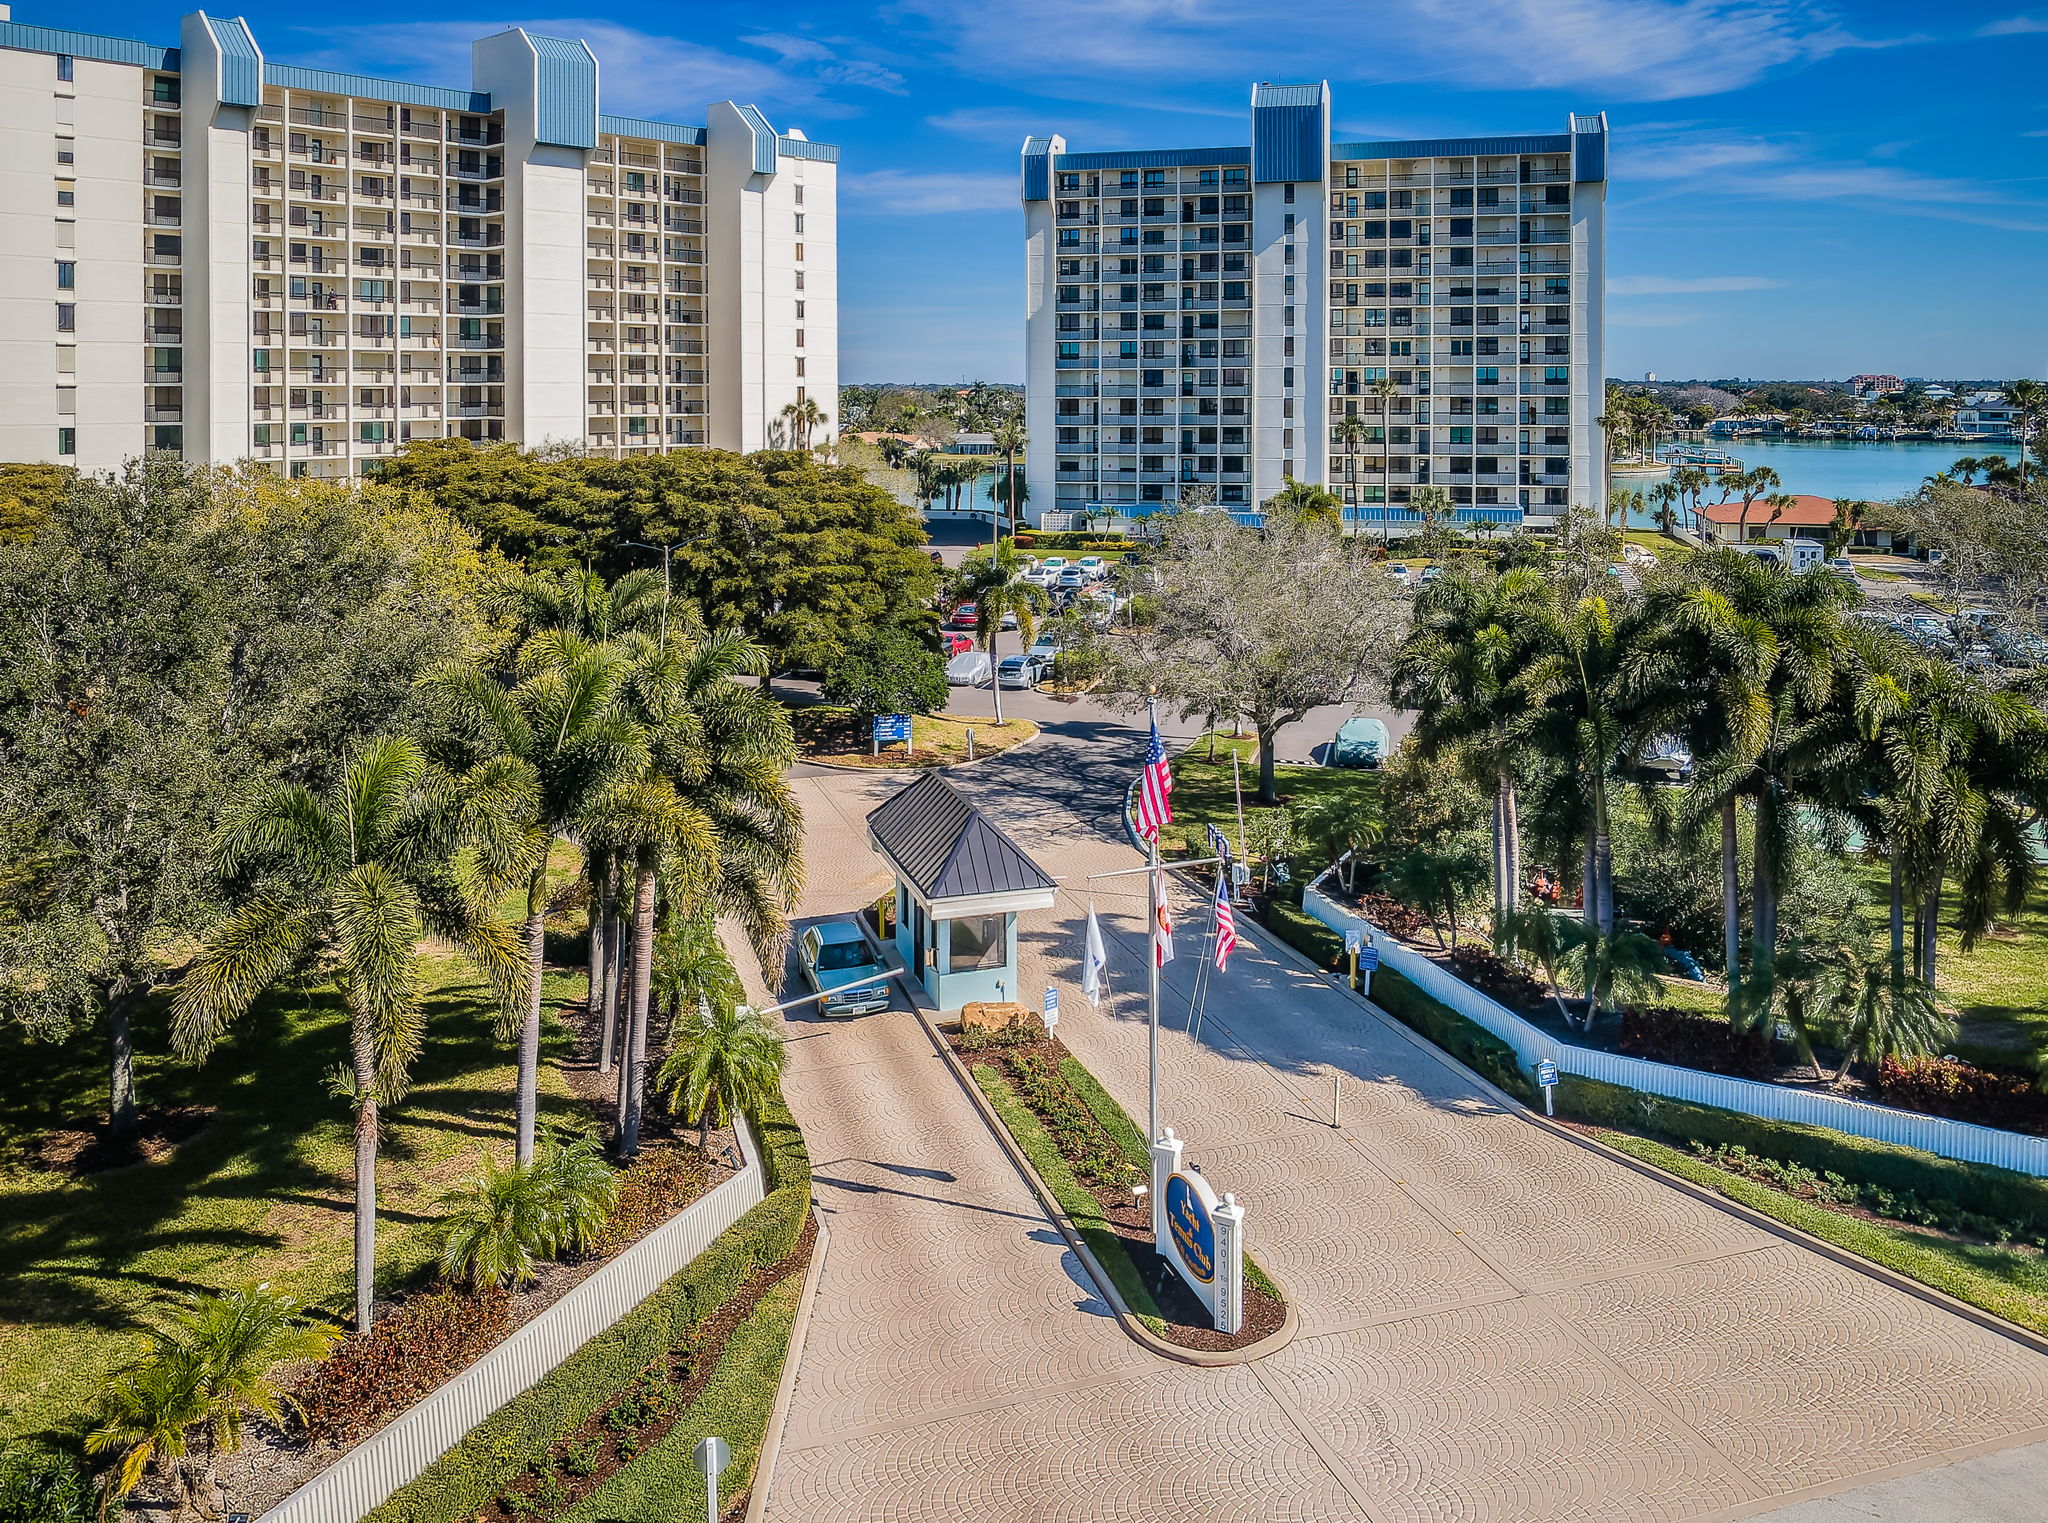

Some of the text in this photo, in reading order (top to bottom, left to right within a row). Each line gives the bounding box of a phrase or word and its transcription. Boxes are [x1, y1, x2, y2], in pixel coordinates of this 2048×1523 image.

[1181, 1200, 1200, 1232] Yacht
[1170, 1212, 1193, 1248] Tennis
[1193, 1242, 1211, 1271] Club
[1219, 1274, 1228, 1283] To
